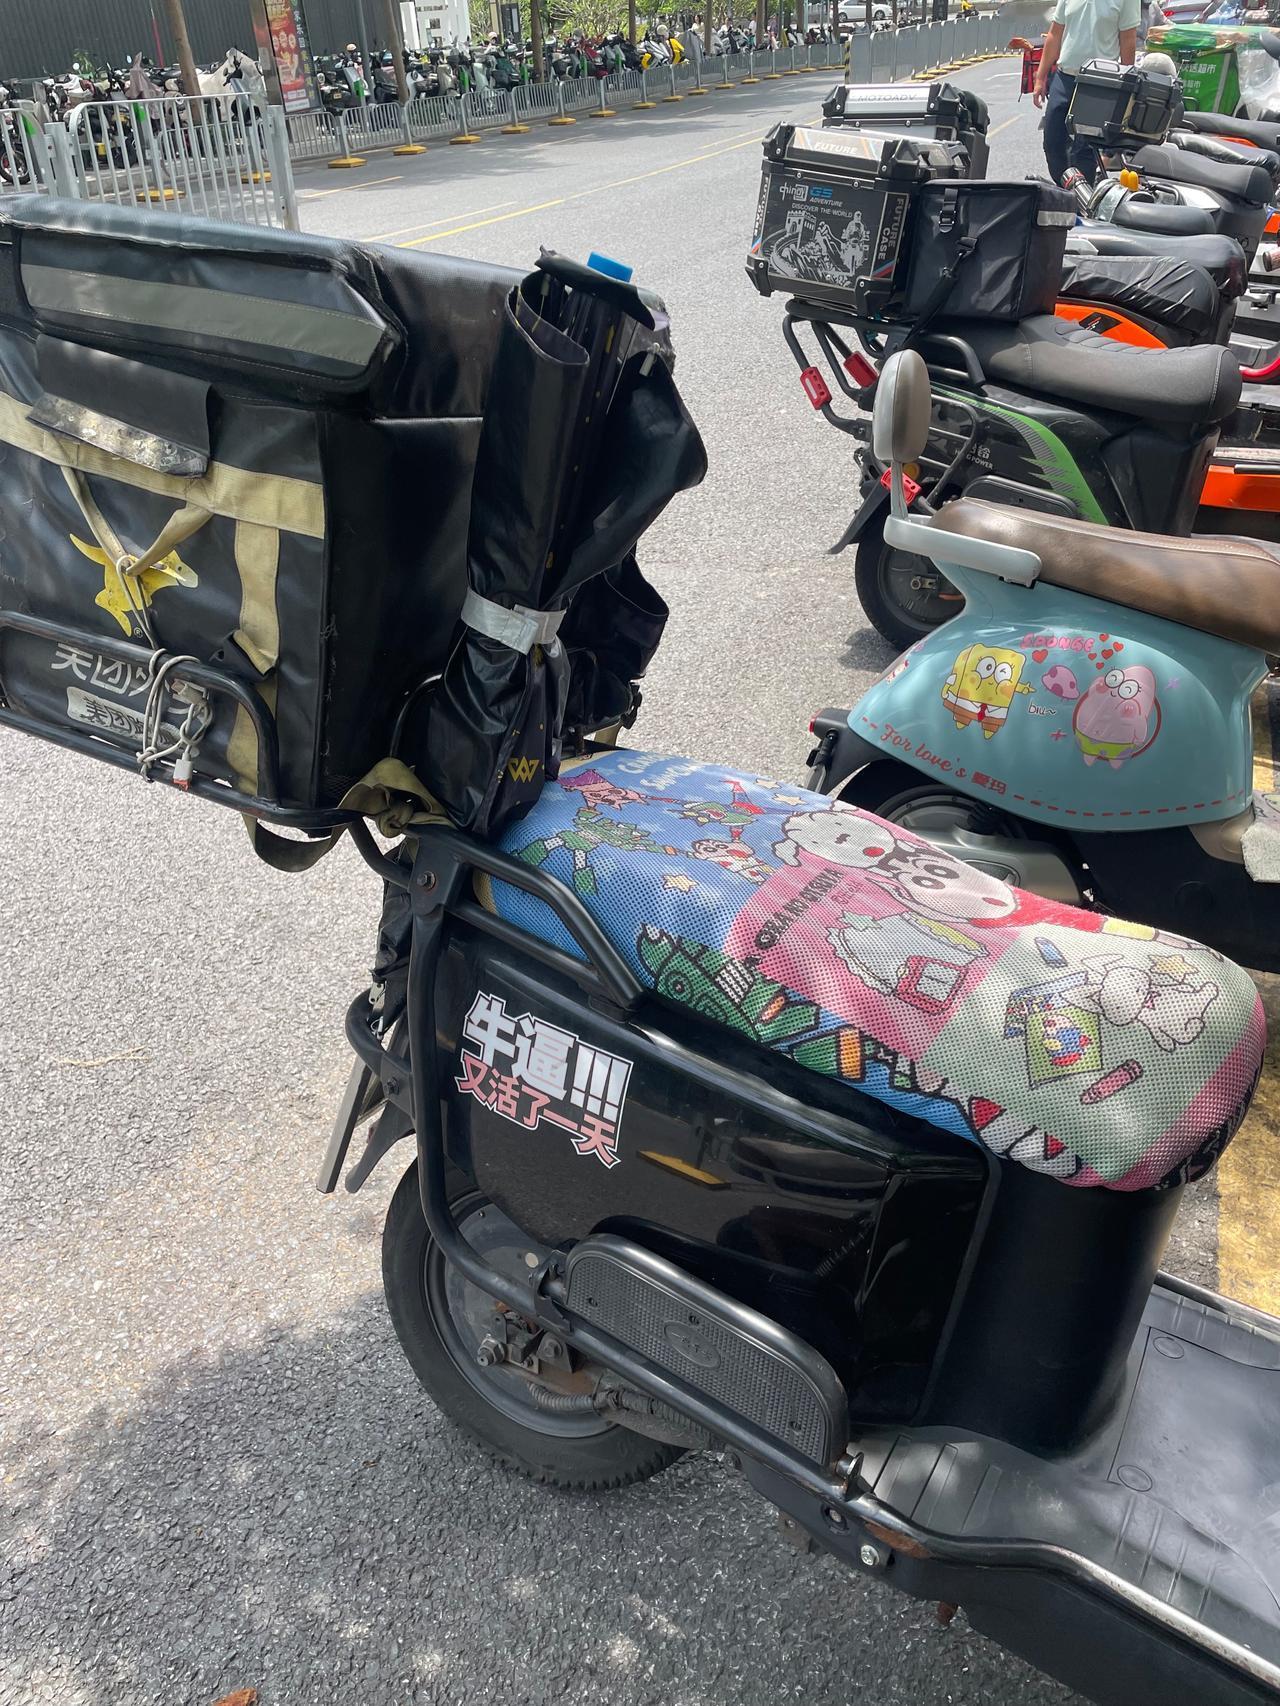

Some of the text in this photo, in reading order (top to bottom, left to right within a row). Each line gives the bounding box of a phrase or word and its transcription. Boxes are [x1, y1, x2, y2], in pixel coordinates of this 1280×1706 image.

[813, 142, 858, 155] FUTURE
[810, 185, 833, 198] GS
[810, 197, 843, 208] ADVENTURE
[791, 202, 819, 213] DISCOVER
[832, 209, 852, 218] WORLD
[887, 198, 905, 249] FUTURE
[877, 227, 891, 261] CASE
[880, 723, 912, 752] For
[915, 743, 967, 778] love's
[457, 1052, 618, 1167] 又活了一天
